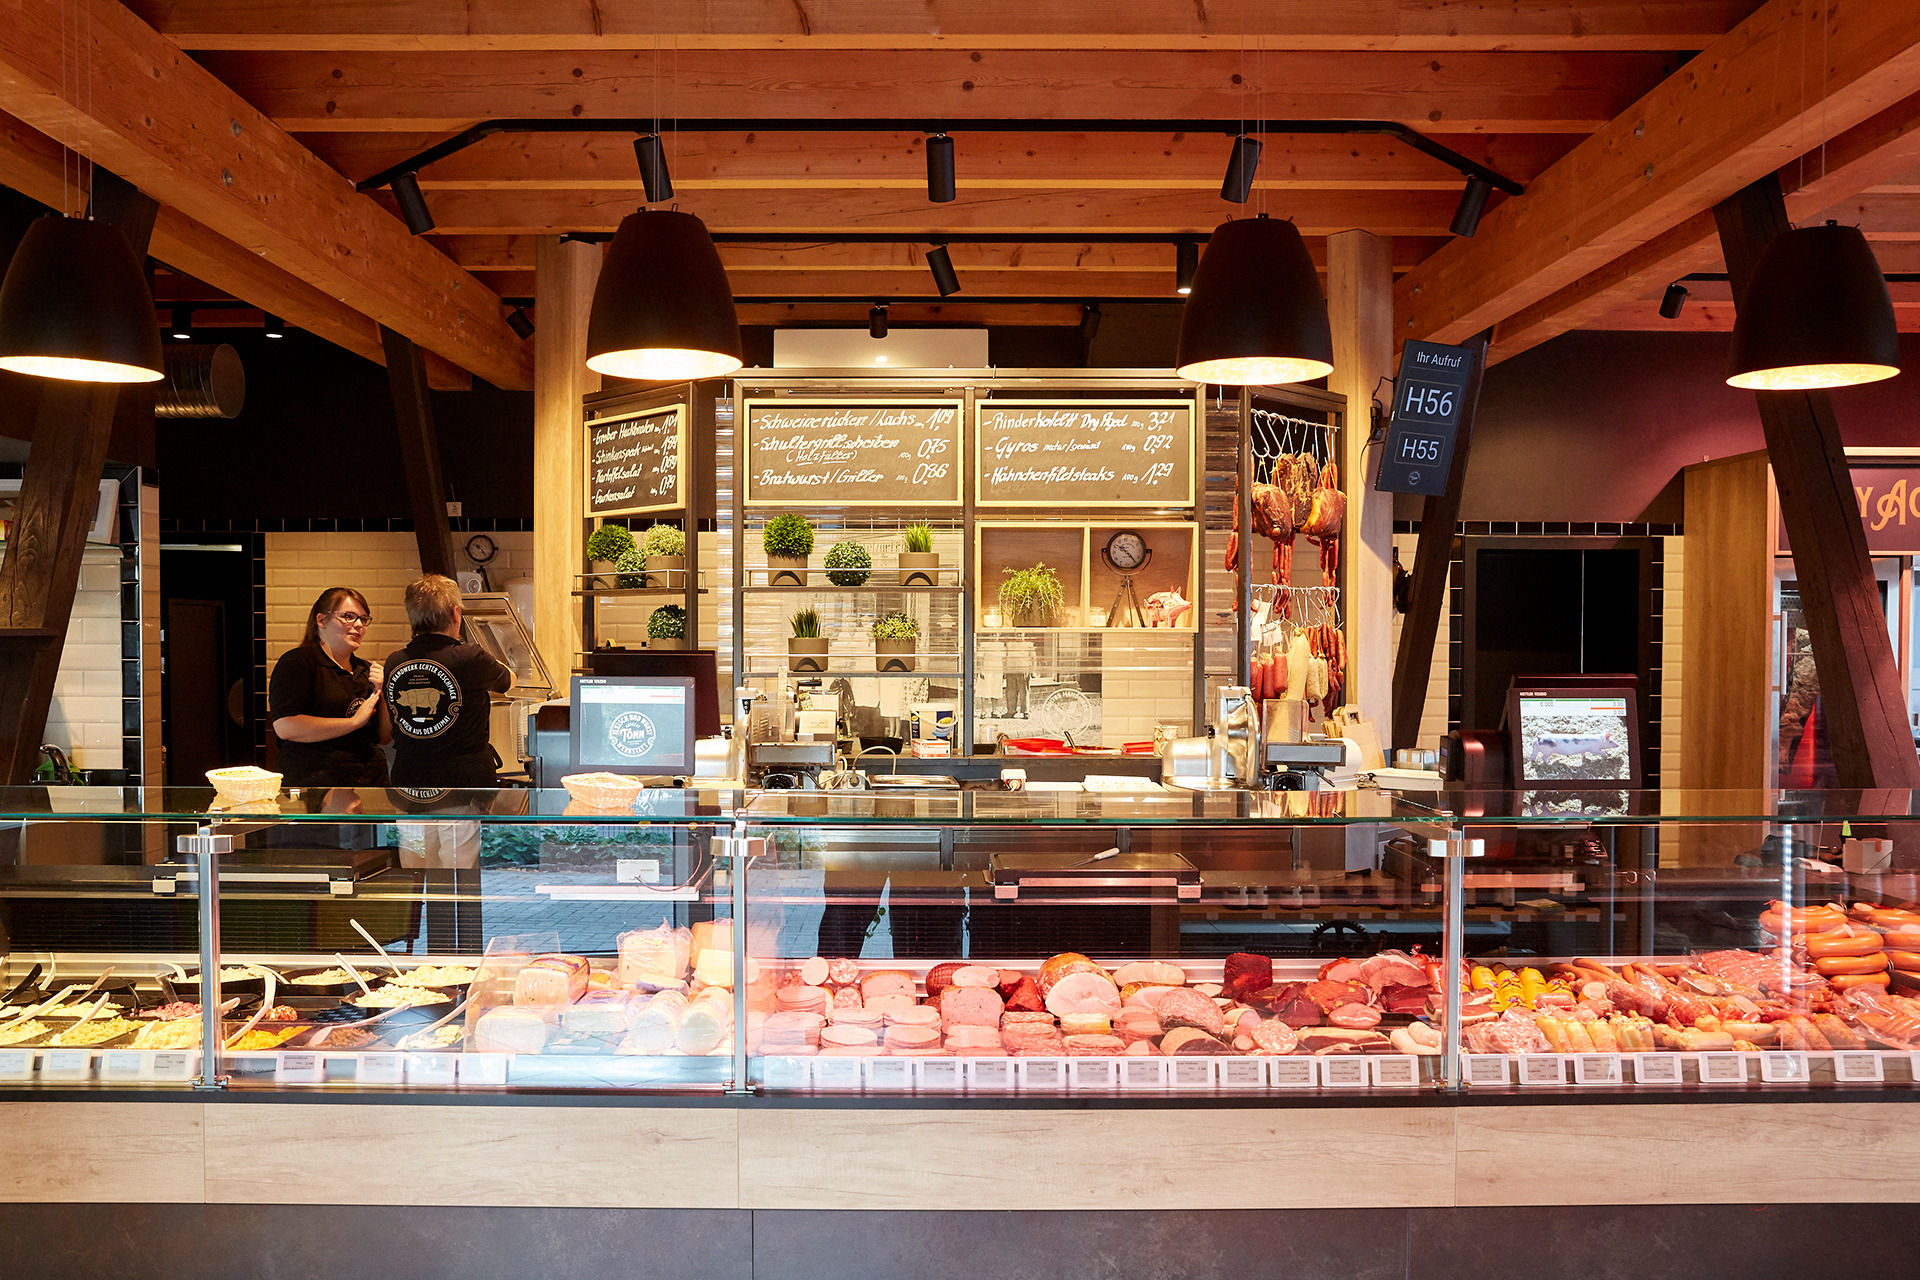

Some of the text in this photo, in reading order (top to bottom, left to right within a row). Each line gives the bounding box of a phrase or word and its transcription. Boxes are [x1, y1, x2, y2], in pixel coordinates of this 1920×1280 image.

[1416, 351, 1462, 368] Ihr Aufruf
[1405, 386, 1453, 417] H56
[1147, 411, 1176, 431] 3,21
[917, 438, 951, 460] 0,75
[1143, 434, 1174, 454] 0,92
[1401, 438, 1439, 461] H55
[912, 462, 950, 485] 0,86
[1140, 462, 1174, 486] 1,29
[391, 663, 419, 683] HANDWERK
[419, 663, 438, 674] ECHTER
[433, 715, 451, 732] HEIMAT
